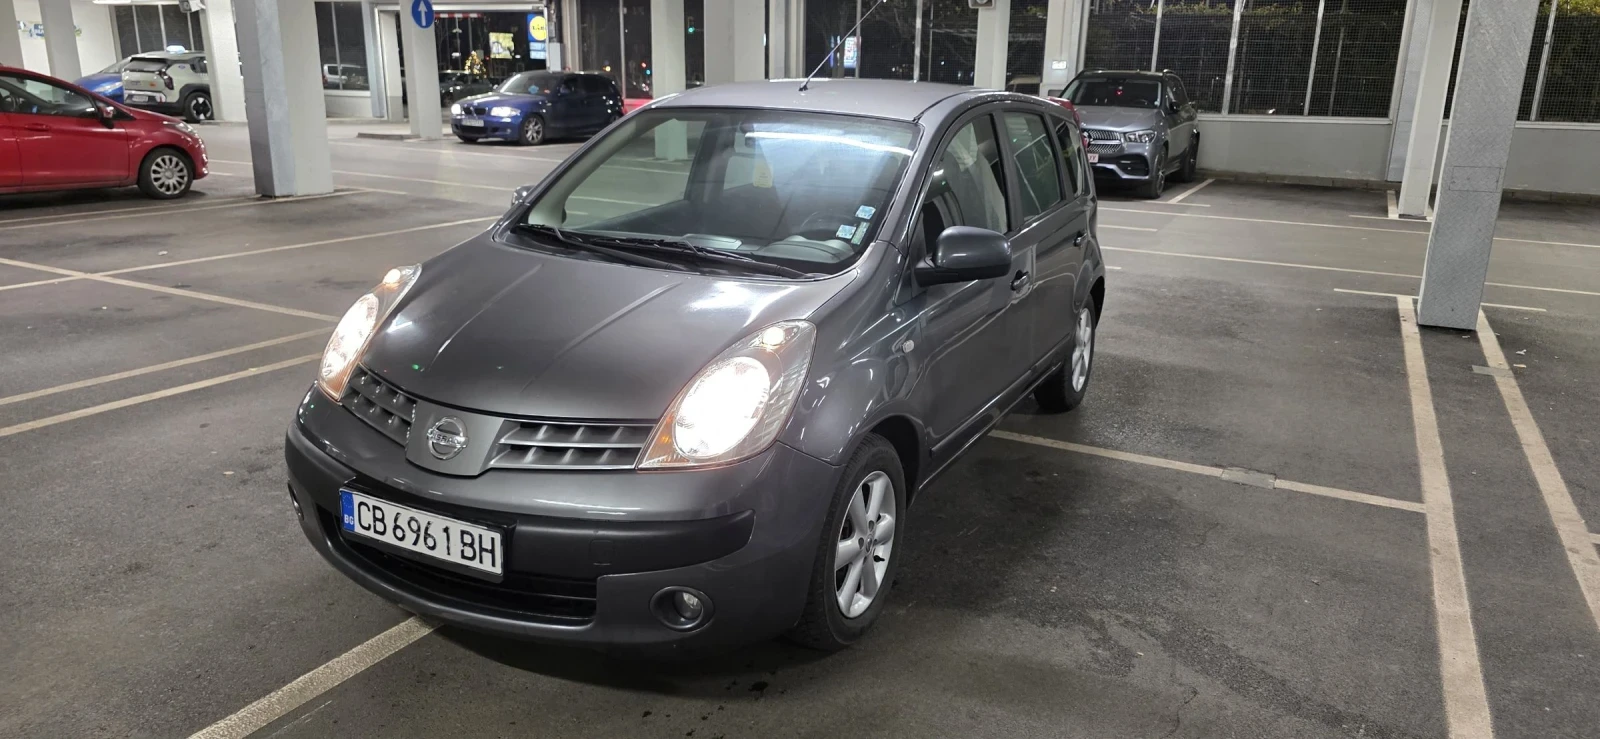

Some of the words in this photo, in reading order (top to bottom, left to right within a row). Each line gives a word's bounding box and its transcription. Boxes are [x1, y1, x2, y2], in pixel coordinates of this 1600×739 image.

[343, 514, 354, 525] BG
[357, 501, 387, 536] CB
[392, 512, 451, 556] 6961
[460, 529, 496, 568] BH
